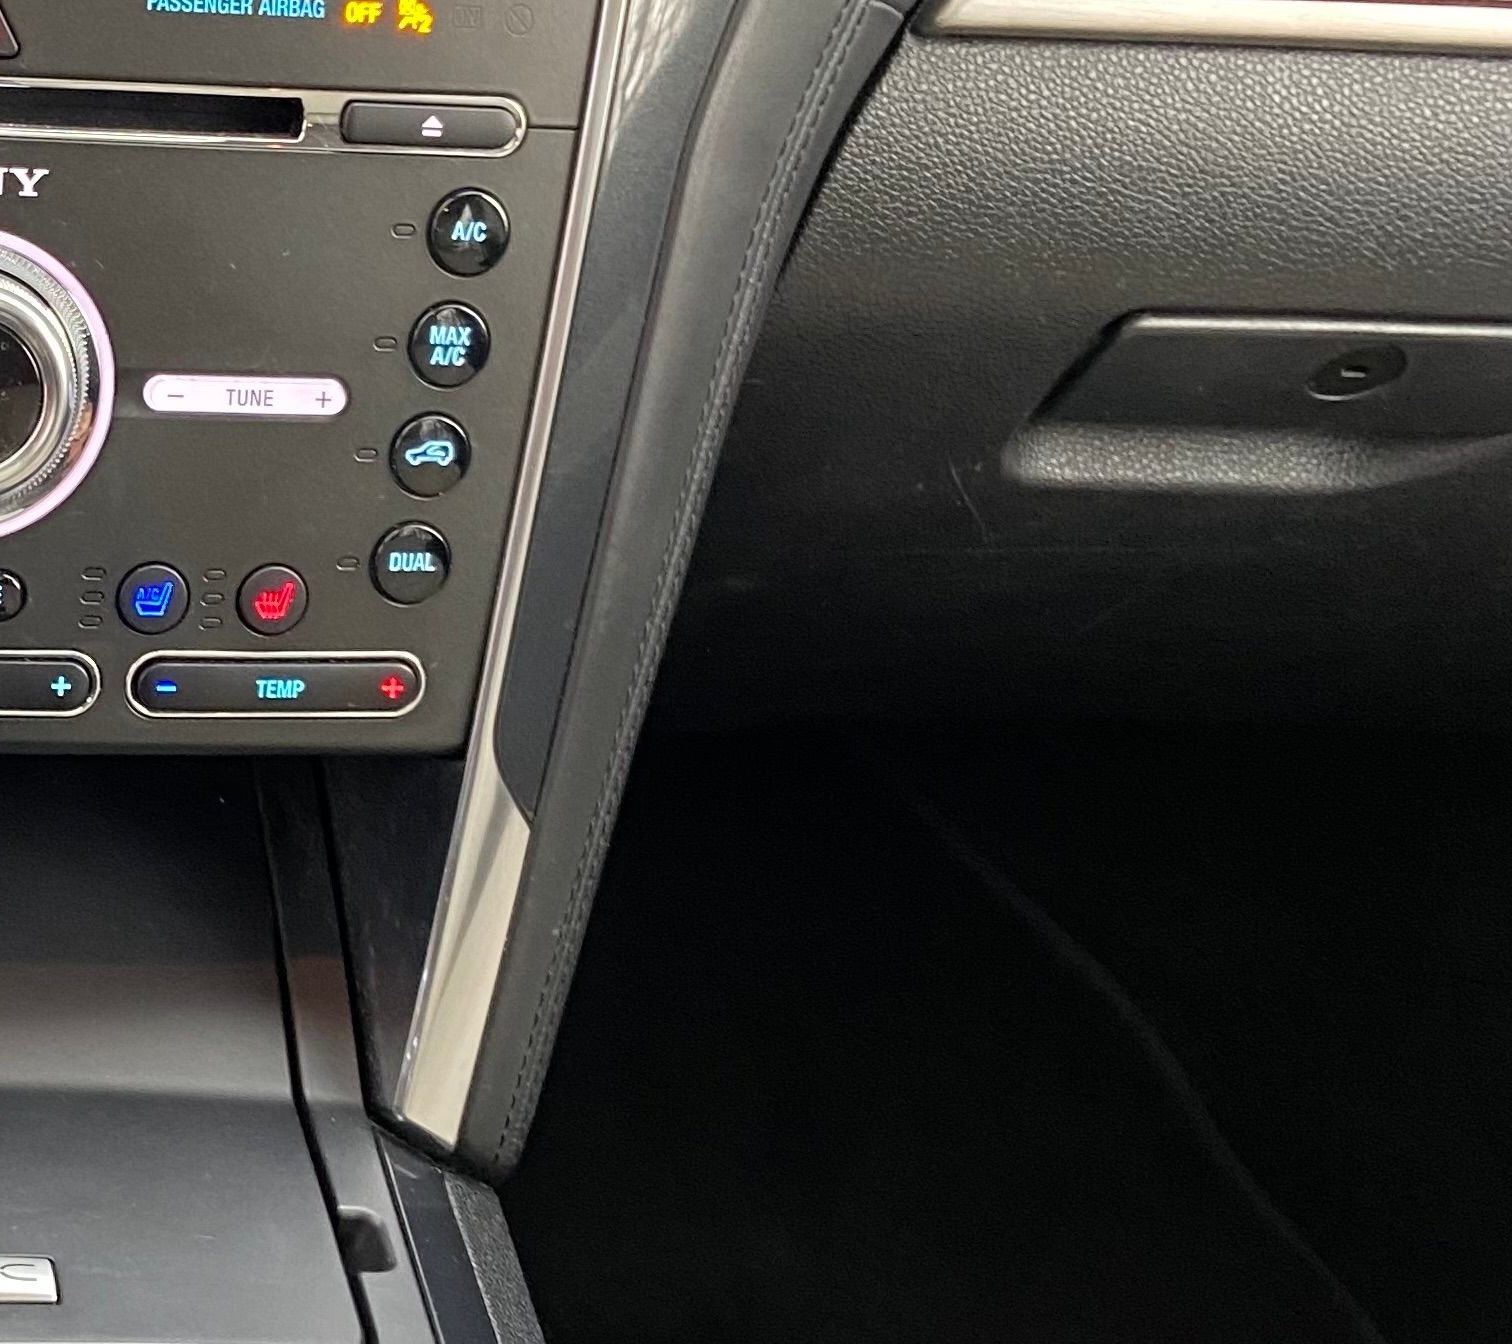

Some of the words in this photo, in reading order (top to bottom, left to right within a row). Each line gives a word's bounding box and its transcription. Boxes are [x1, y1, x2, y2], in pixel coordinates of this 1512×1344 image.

[344, 1, 384, 24] OFF
[451, 221, 488, 244] A/C
[429, 324, 471, 346] MAX
[429, 345, 466, 367] A/C
[225, 388, 275, 408] TUNE
[388, 551, 437, 573] DUAL
[255, 678, 306, 701] TEMP
